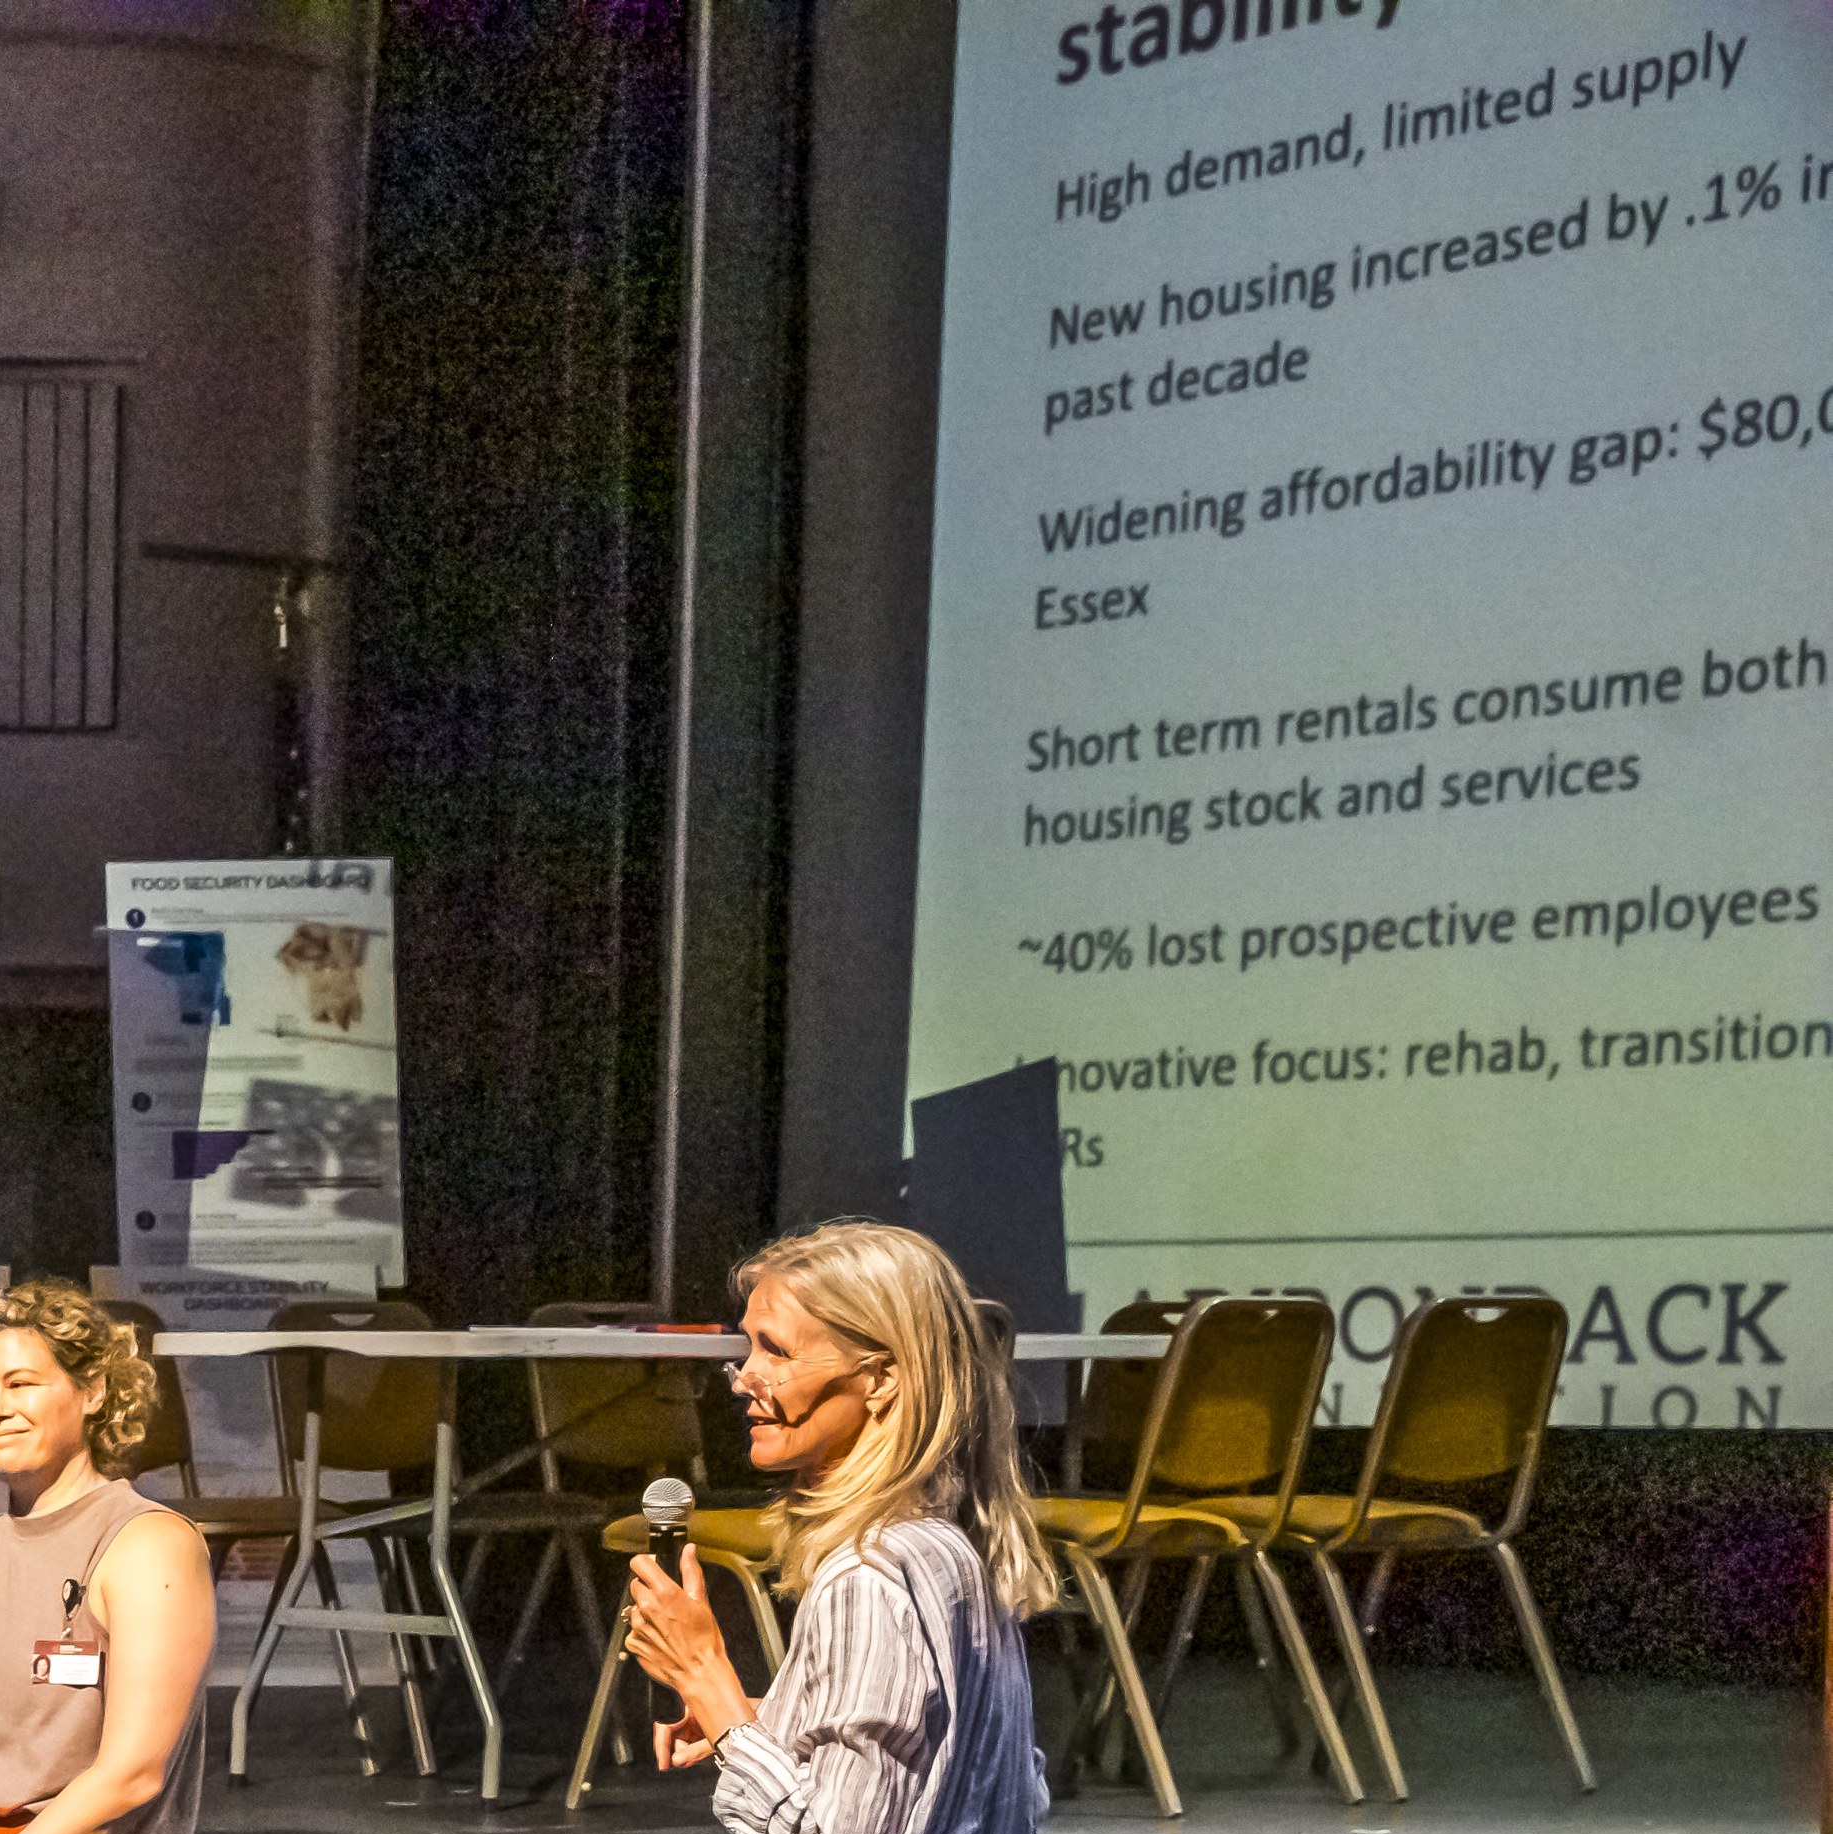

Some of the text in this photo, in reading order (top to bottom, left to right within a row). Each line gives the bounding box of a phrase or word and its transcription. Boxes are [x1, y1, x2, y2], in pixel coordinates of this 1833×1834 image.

[1055, 29, 1748, 224] High demand, limited supply
[1049, 300, 1146, 349] New
[1159, 261, 1337, 327] housing
[1351, 197, 1589, 292] increased
[1606, 192, 1669, 247] by
[1685, 161, 1782, 227] .1%
[1044, 339, 1310, 436] past decade
[1038, 490, 1247, 554] Widening
[1259, 439, 1556, 521] affordability
[1568, 422, 1679, 486] gap:
[1035, 583, 1149, 631] Essex
[1027, 637, 1828, 773] Short term rentals consume both
[1024, 751, 1641, 847] housing stock and services
[131, 877, 180, 890] FOOD
[183, 876, 263, 890] SECURITY
[1018, 884, 1820, 973] ~40% lost prospective employees
[1016, 1013, 1833, 1092] novative focus: rehab, transition
